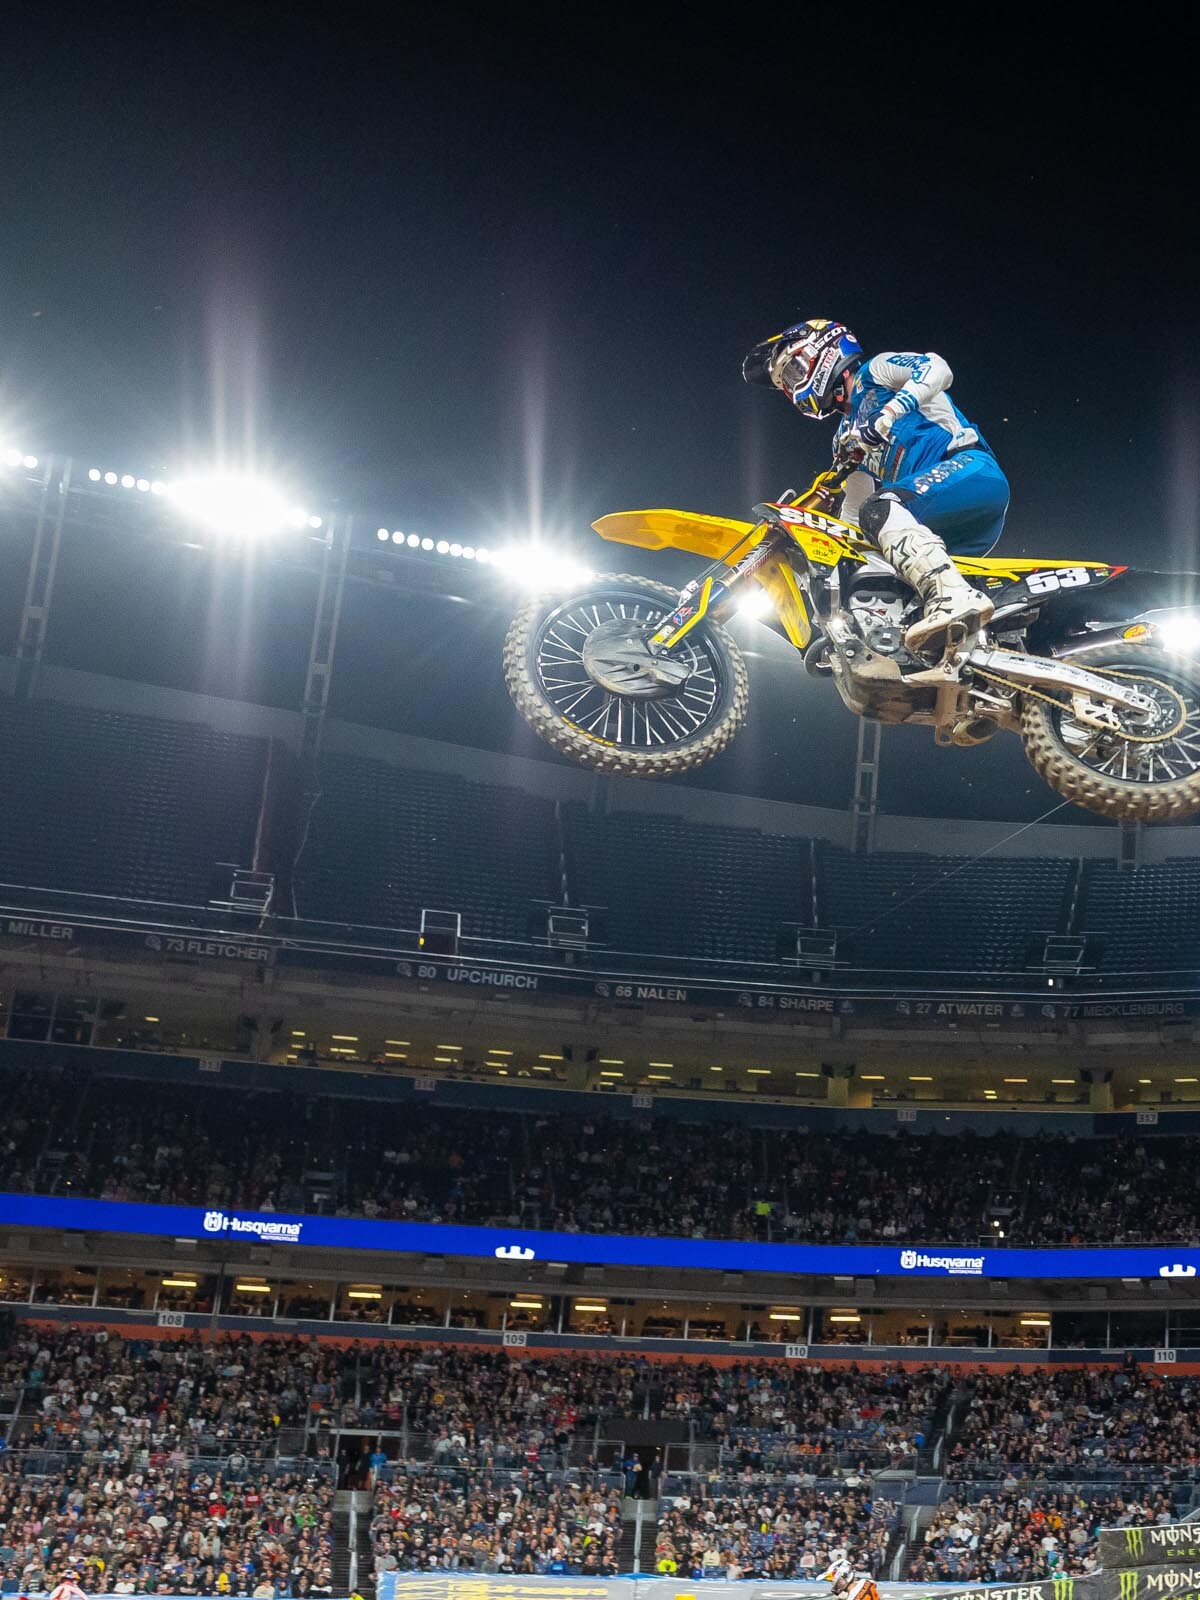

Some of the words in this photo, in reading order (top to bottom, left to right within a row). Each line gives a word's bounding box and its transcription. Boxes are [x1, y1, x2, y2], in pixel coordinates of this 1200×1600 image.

[1025, 567, 1091, 594] 53
[8, 921, 73, 940] MILLER
[166, 938, 184, 951] 73
[187, 940, 268, 961] FLETCHER
[417, 965, 437, 979] 80
[447, 967, 539, 990] UPCHURCH
[615, 985, 632, 999] 66
[637, 987, 687, 1001] NALEN
[779, 997, 835, 1012] SHARPE
[915, 1002, 930, 1015] 27
[1083, 1002, 1185, 1018] MECKLENBURG
[222, 1217, 302, 1235] Husqvarna
[917, 1255, 984, 1269] Husqvarna
[162, 1314, 182, 1326] 108
[505, 1334, 525, 1345] 109
[788, 1347, 806, 1357] 110
[1157, 1351, 1174, 1361] 110
[941, 1585, 1046, 1600] NSTER
